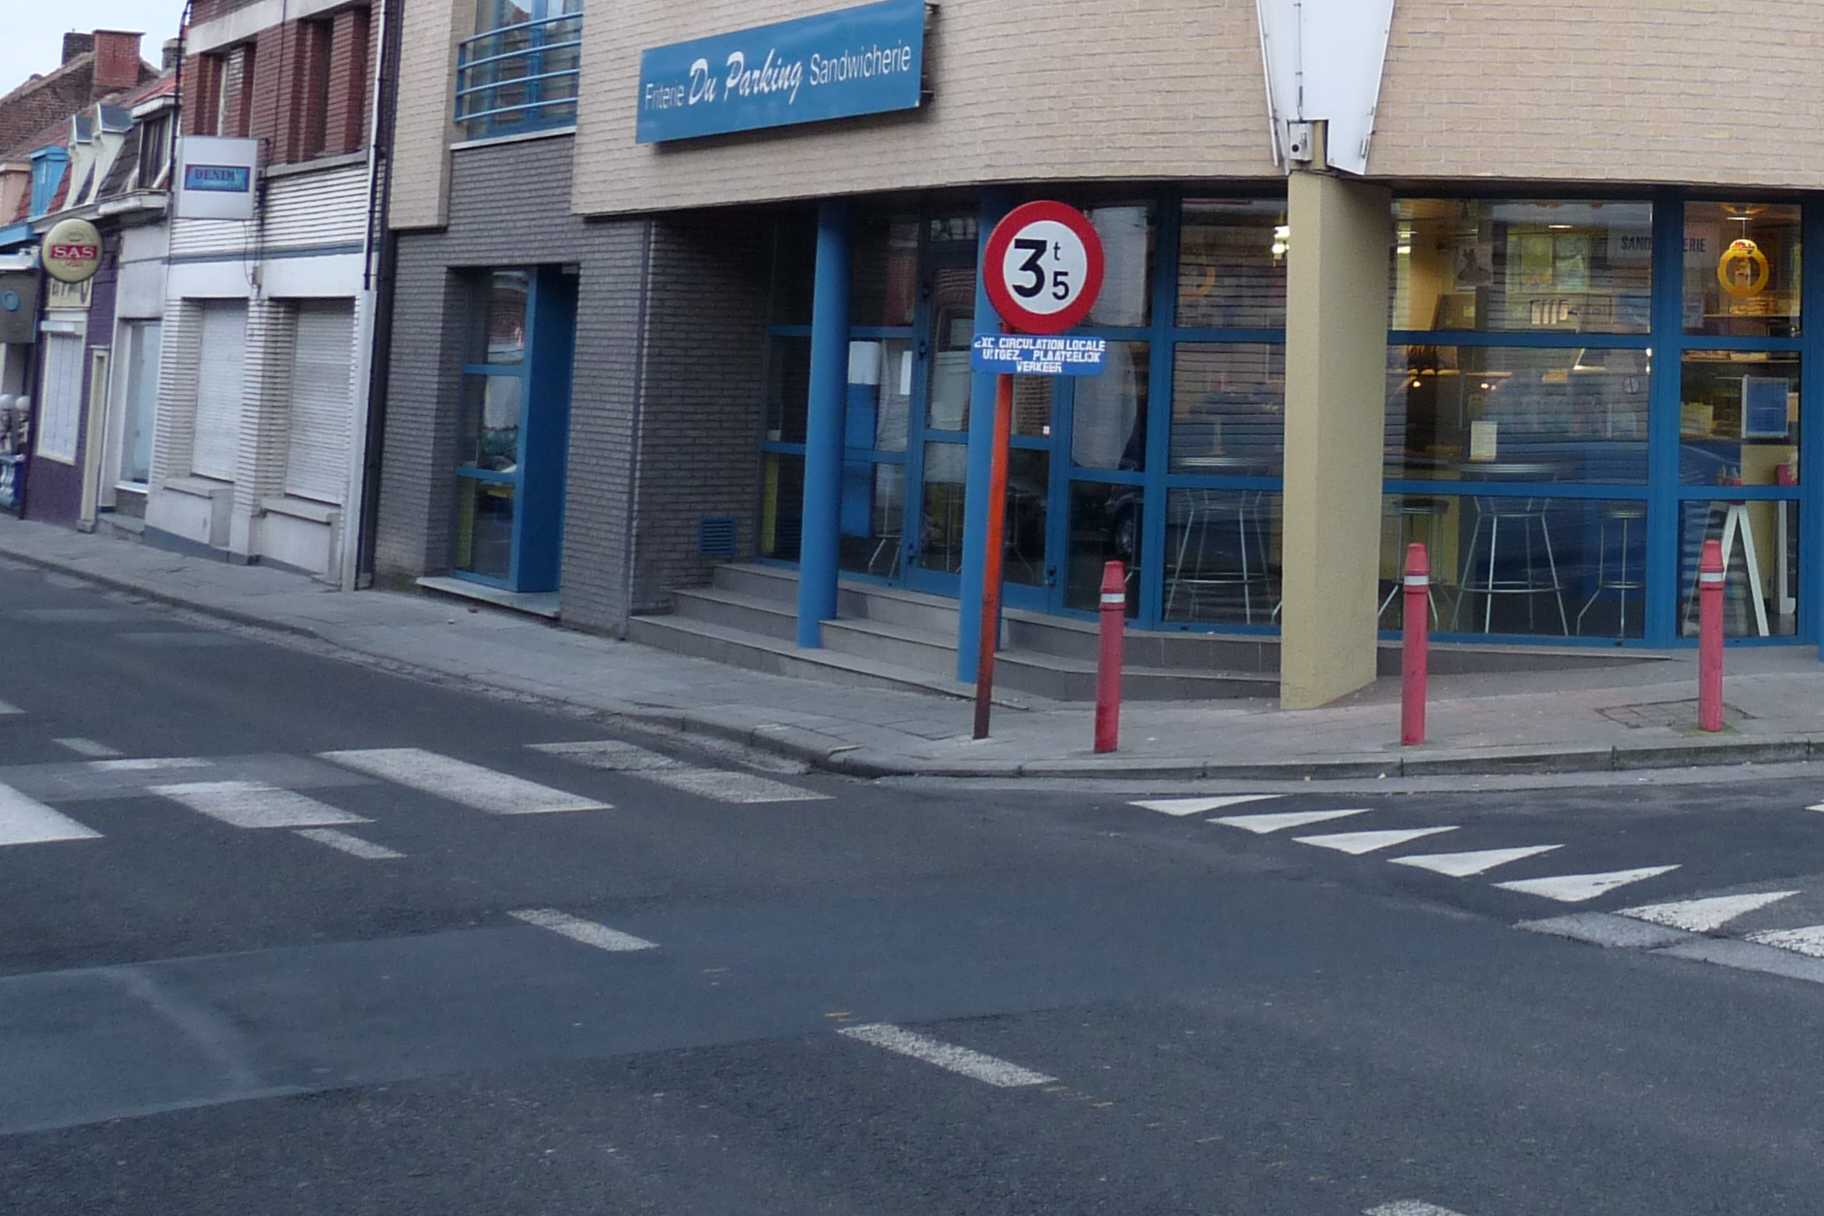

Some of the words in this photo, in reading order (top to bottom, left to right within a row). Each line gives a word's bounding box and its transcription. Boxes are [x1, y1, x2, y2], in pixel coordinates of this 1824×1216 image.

[645, 80, 685, 110] Friterie
[688, 58, 717, 105] Du
[723, 48, 802, 105] Parking
[809, 39, 911, 86] Sandwicherie
[54, 246, 95, 259] SAS
[1011, 238, 1047, 298] 3
[999, 337, 1064, 350] CIRCULATION
[1066, 340, 1105, 351] LOCALE
